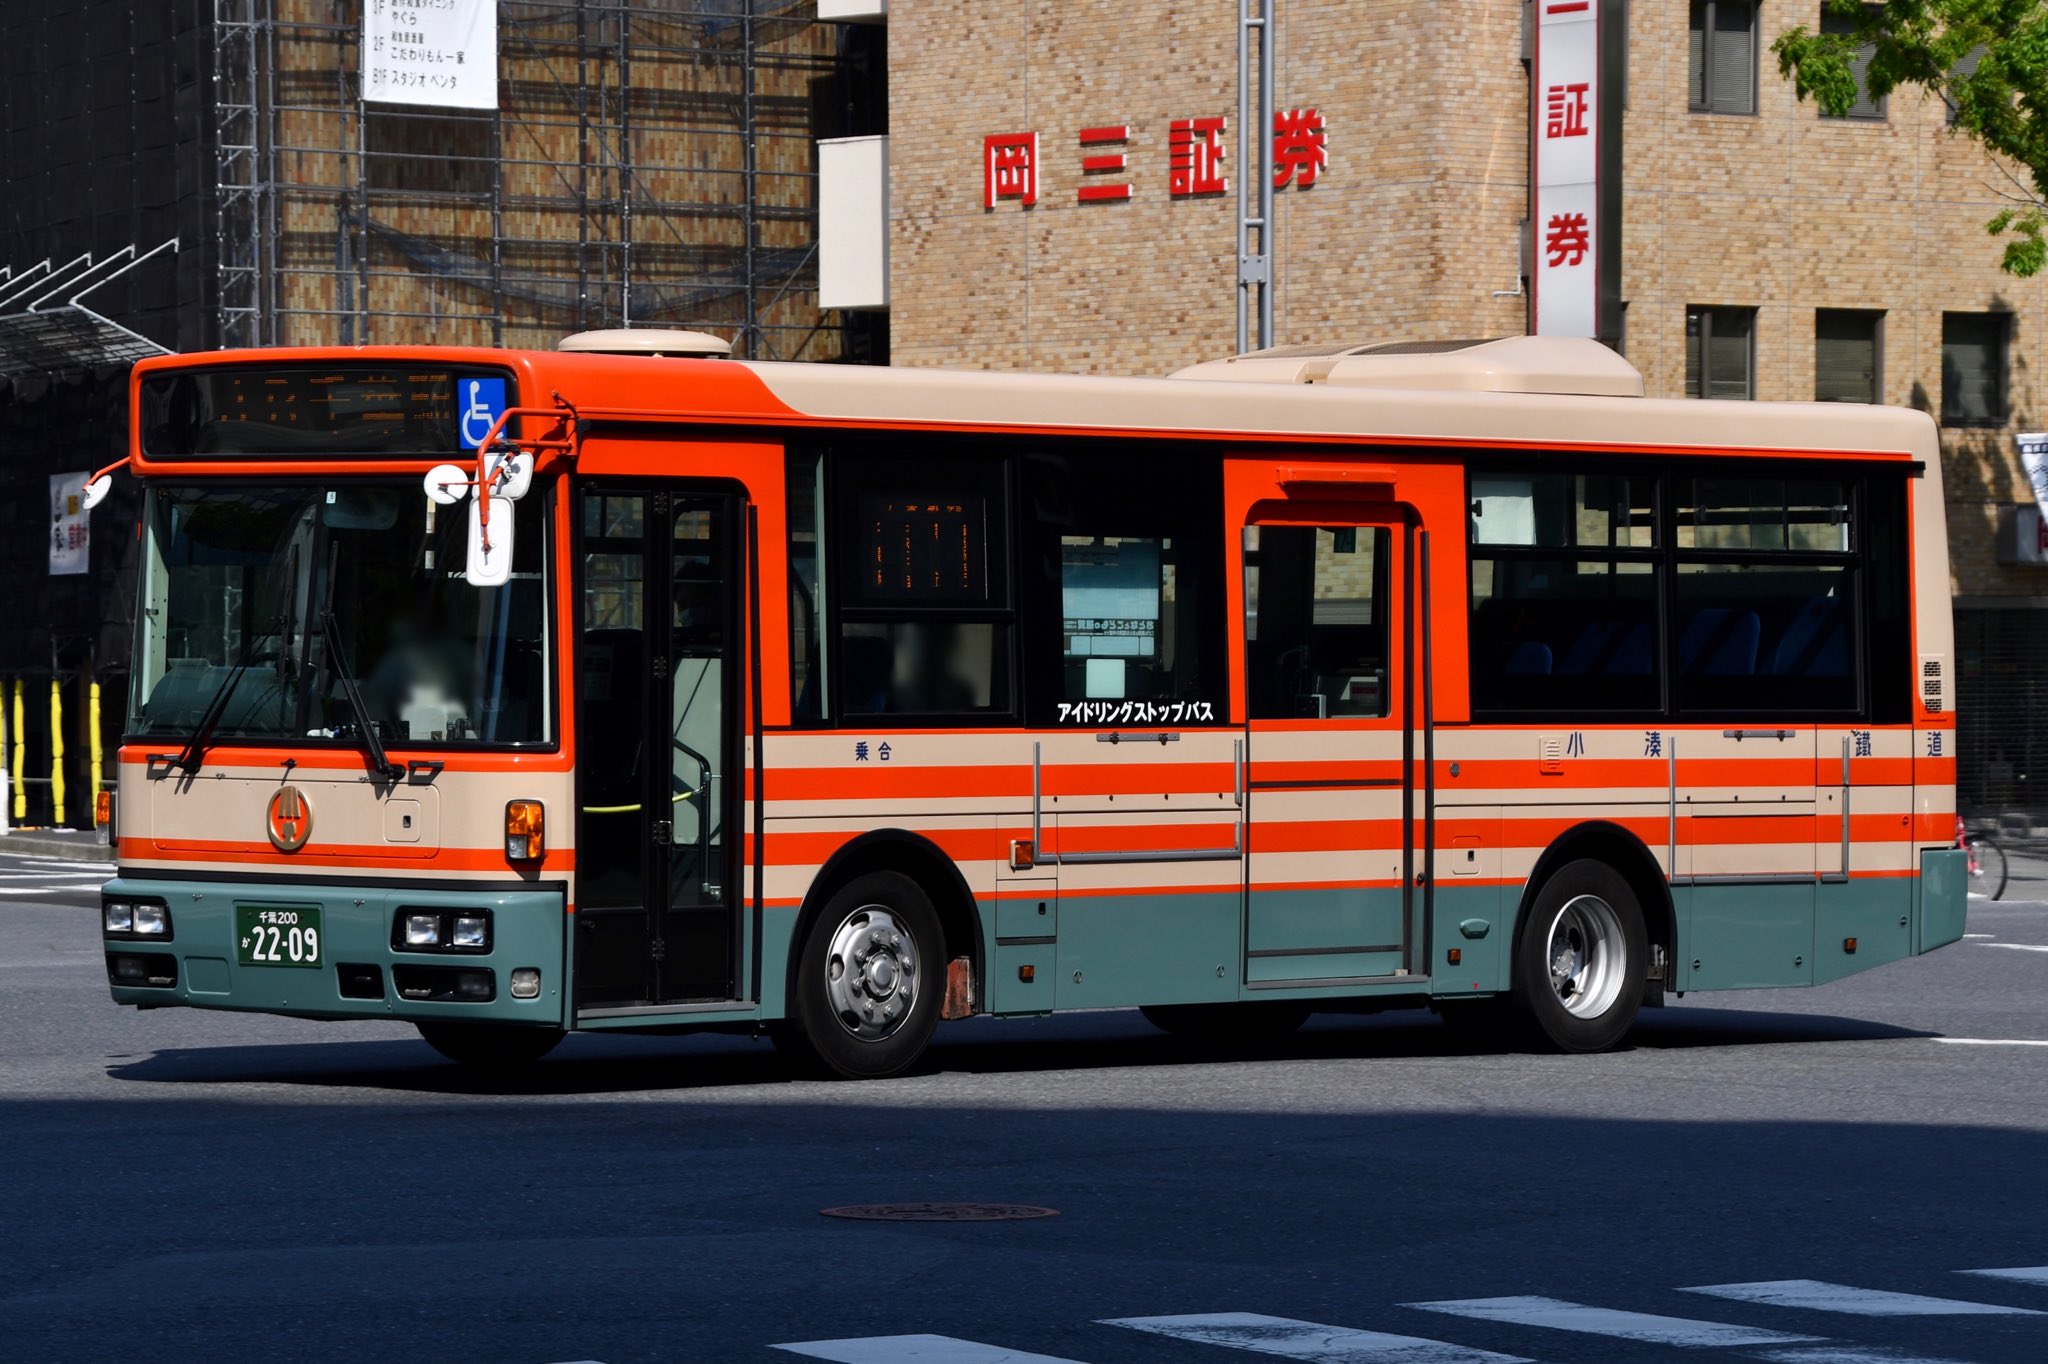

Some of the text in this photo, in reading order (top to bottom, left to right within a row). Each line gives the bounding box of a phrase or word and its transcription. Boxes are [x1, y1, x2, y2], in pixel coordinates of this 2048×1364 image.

[373, 35, 385, 52] 2F
[984, 108, 1329, 211] 岡三証券
[1057, 701, 1214, 723] アイドリングストップバス
[855, 741, 892, 761] 乗合
[241, 926, 318, 962] か 22-09
